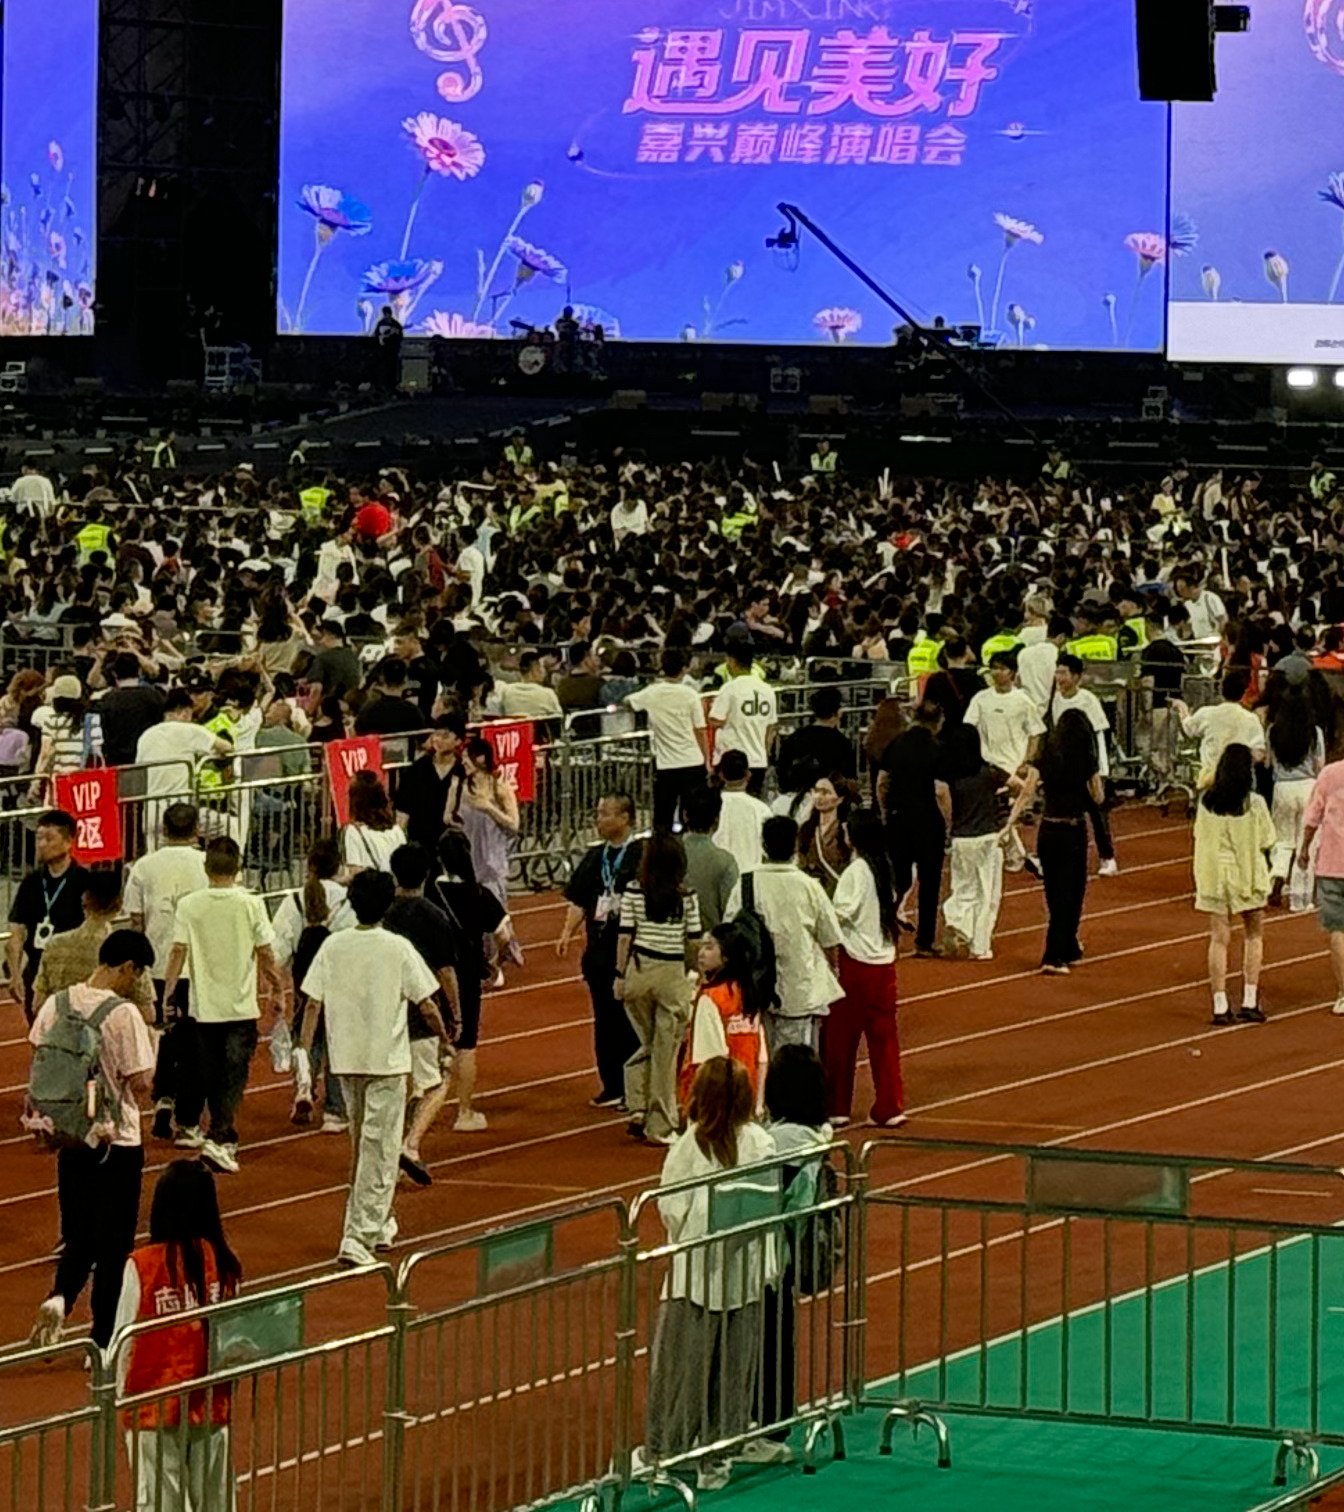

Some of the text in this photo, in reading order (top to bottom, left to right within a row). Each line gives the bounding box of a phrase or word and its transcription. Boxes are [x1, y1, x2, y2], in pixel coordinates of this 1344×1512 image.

[622, 26, 1003, 117] 遇见美好
[636, 122, 968, 166] 嘉兴巅峰演唱会
[496, 731, 520, 759] VIP
[341, 747, 368, 778] VIP
[72, 780, 102, 813] VIP
[76, 816, 105, 849] 2区
